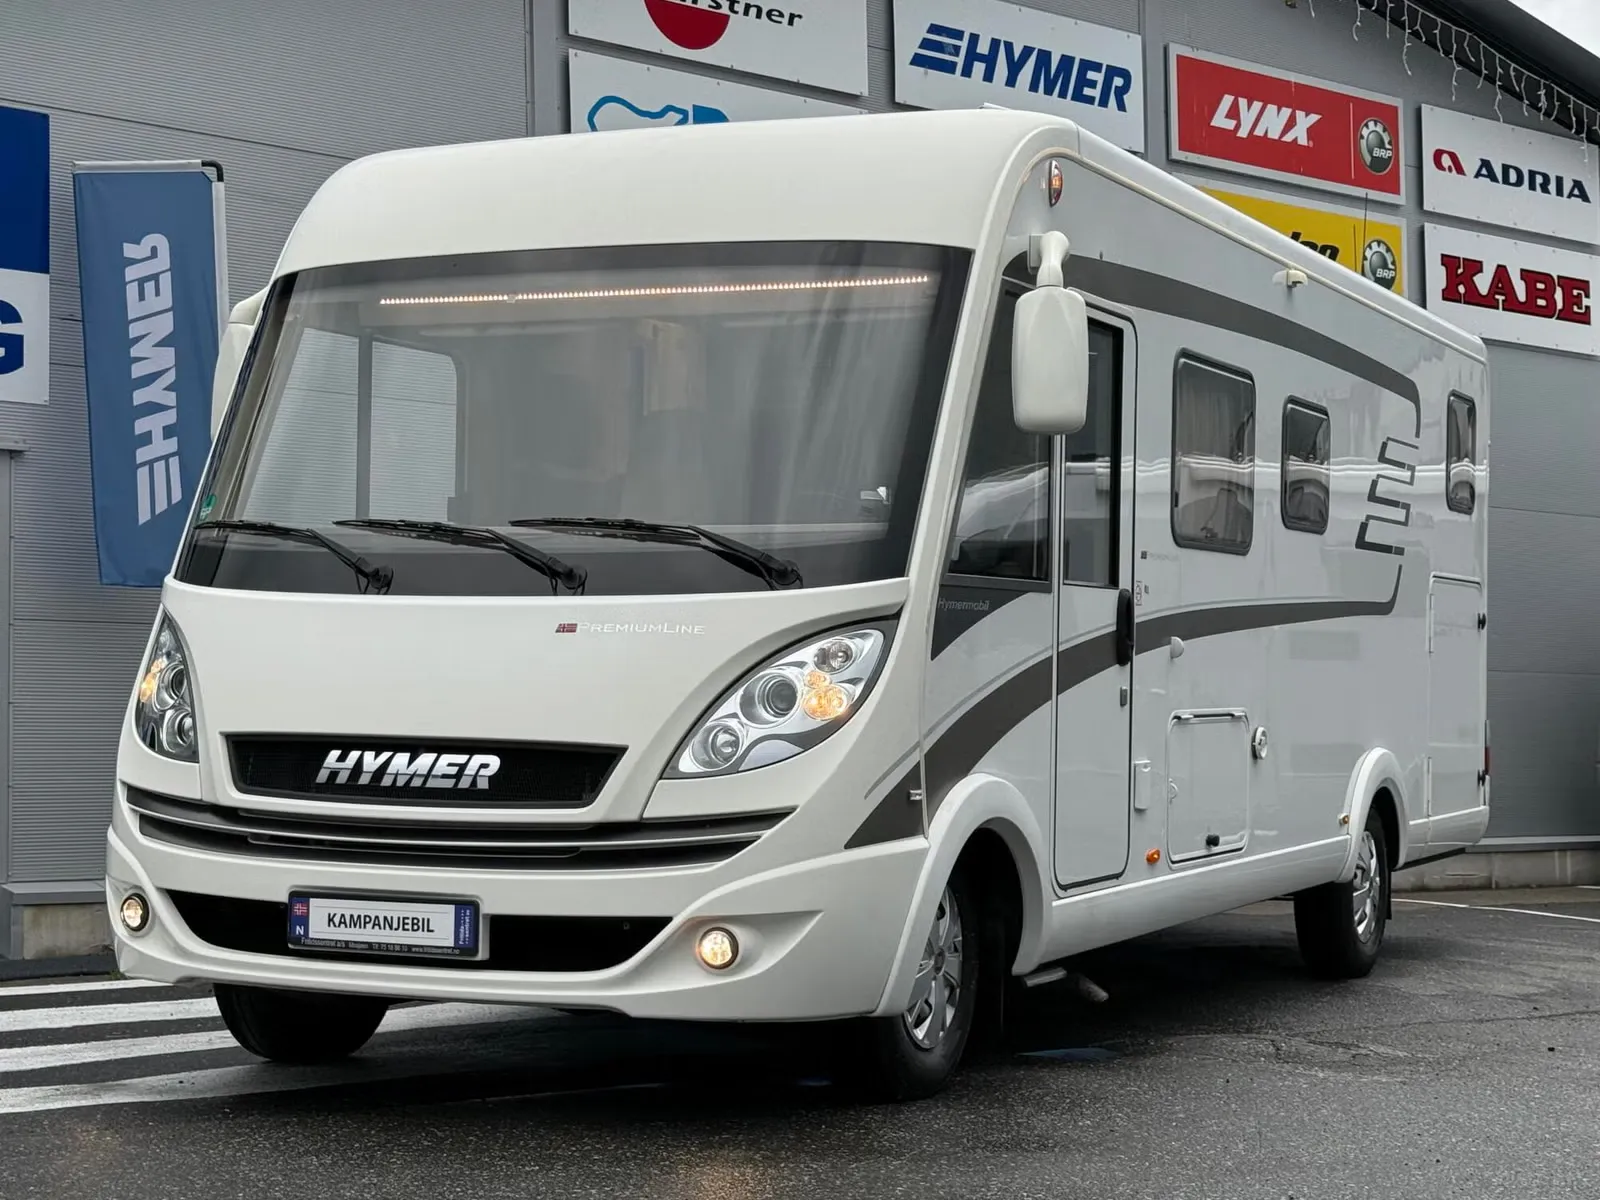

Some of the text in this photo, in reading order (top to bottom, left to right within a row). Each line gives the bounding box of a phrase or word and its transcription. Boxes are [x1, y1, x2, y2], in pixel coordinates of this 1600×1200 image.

[960, 32, 1133, 113] HYMER
[1210, 93, 1322, 147] LYNX
[1372, 147, 1393, 159] BRP
[1473, 157, 1592, 204] ADRIA
[1375, 268, 1396, 279] BRP
[1440, 253, 1592, 326] KABE
[937, 598, 990, 611] Hymermobil
[315, 750, 501, 790] HYMER
[295, 925, 305, 935] N
[327, 912, 435, 933] KAMPANJEBIL
